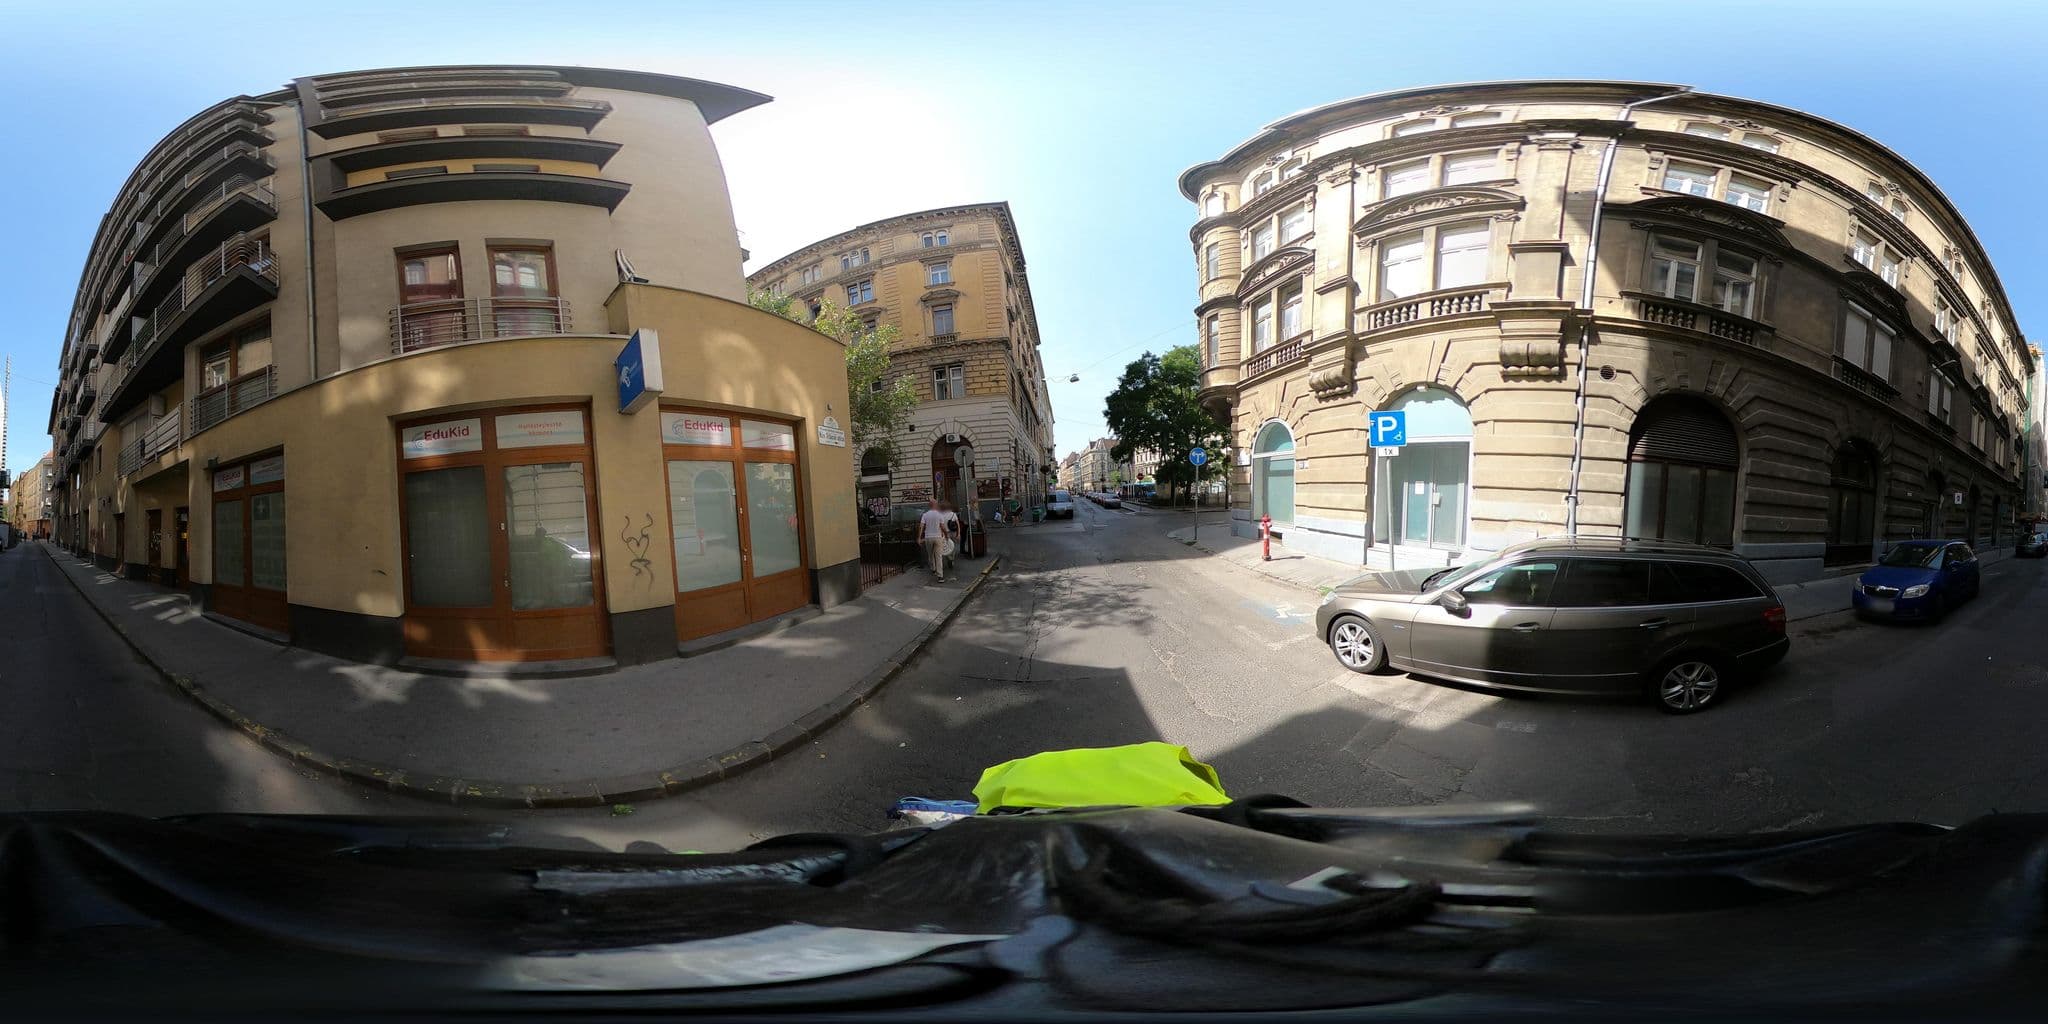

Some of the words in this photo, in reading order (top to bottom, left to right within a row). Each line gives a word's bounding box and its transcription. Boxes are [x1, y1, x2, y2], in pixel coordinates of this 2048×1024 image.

[684, 419, 723, 432] EduKid
[1378, 416, 1397, 442] P
[424, 426, 470, 442] EduKid
